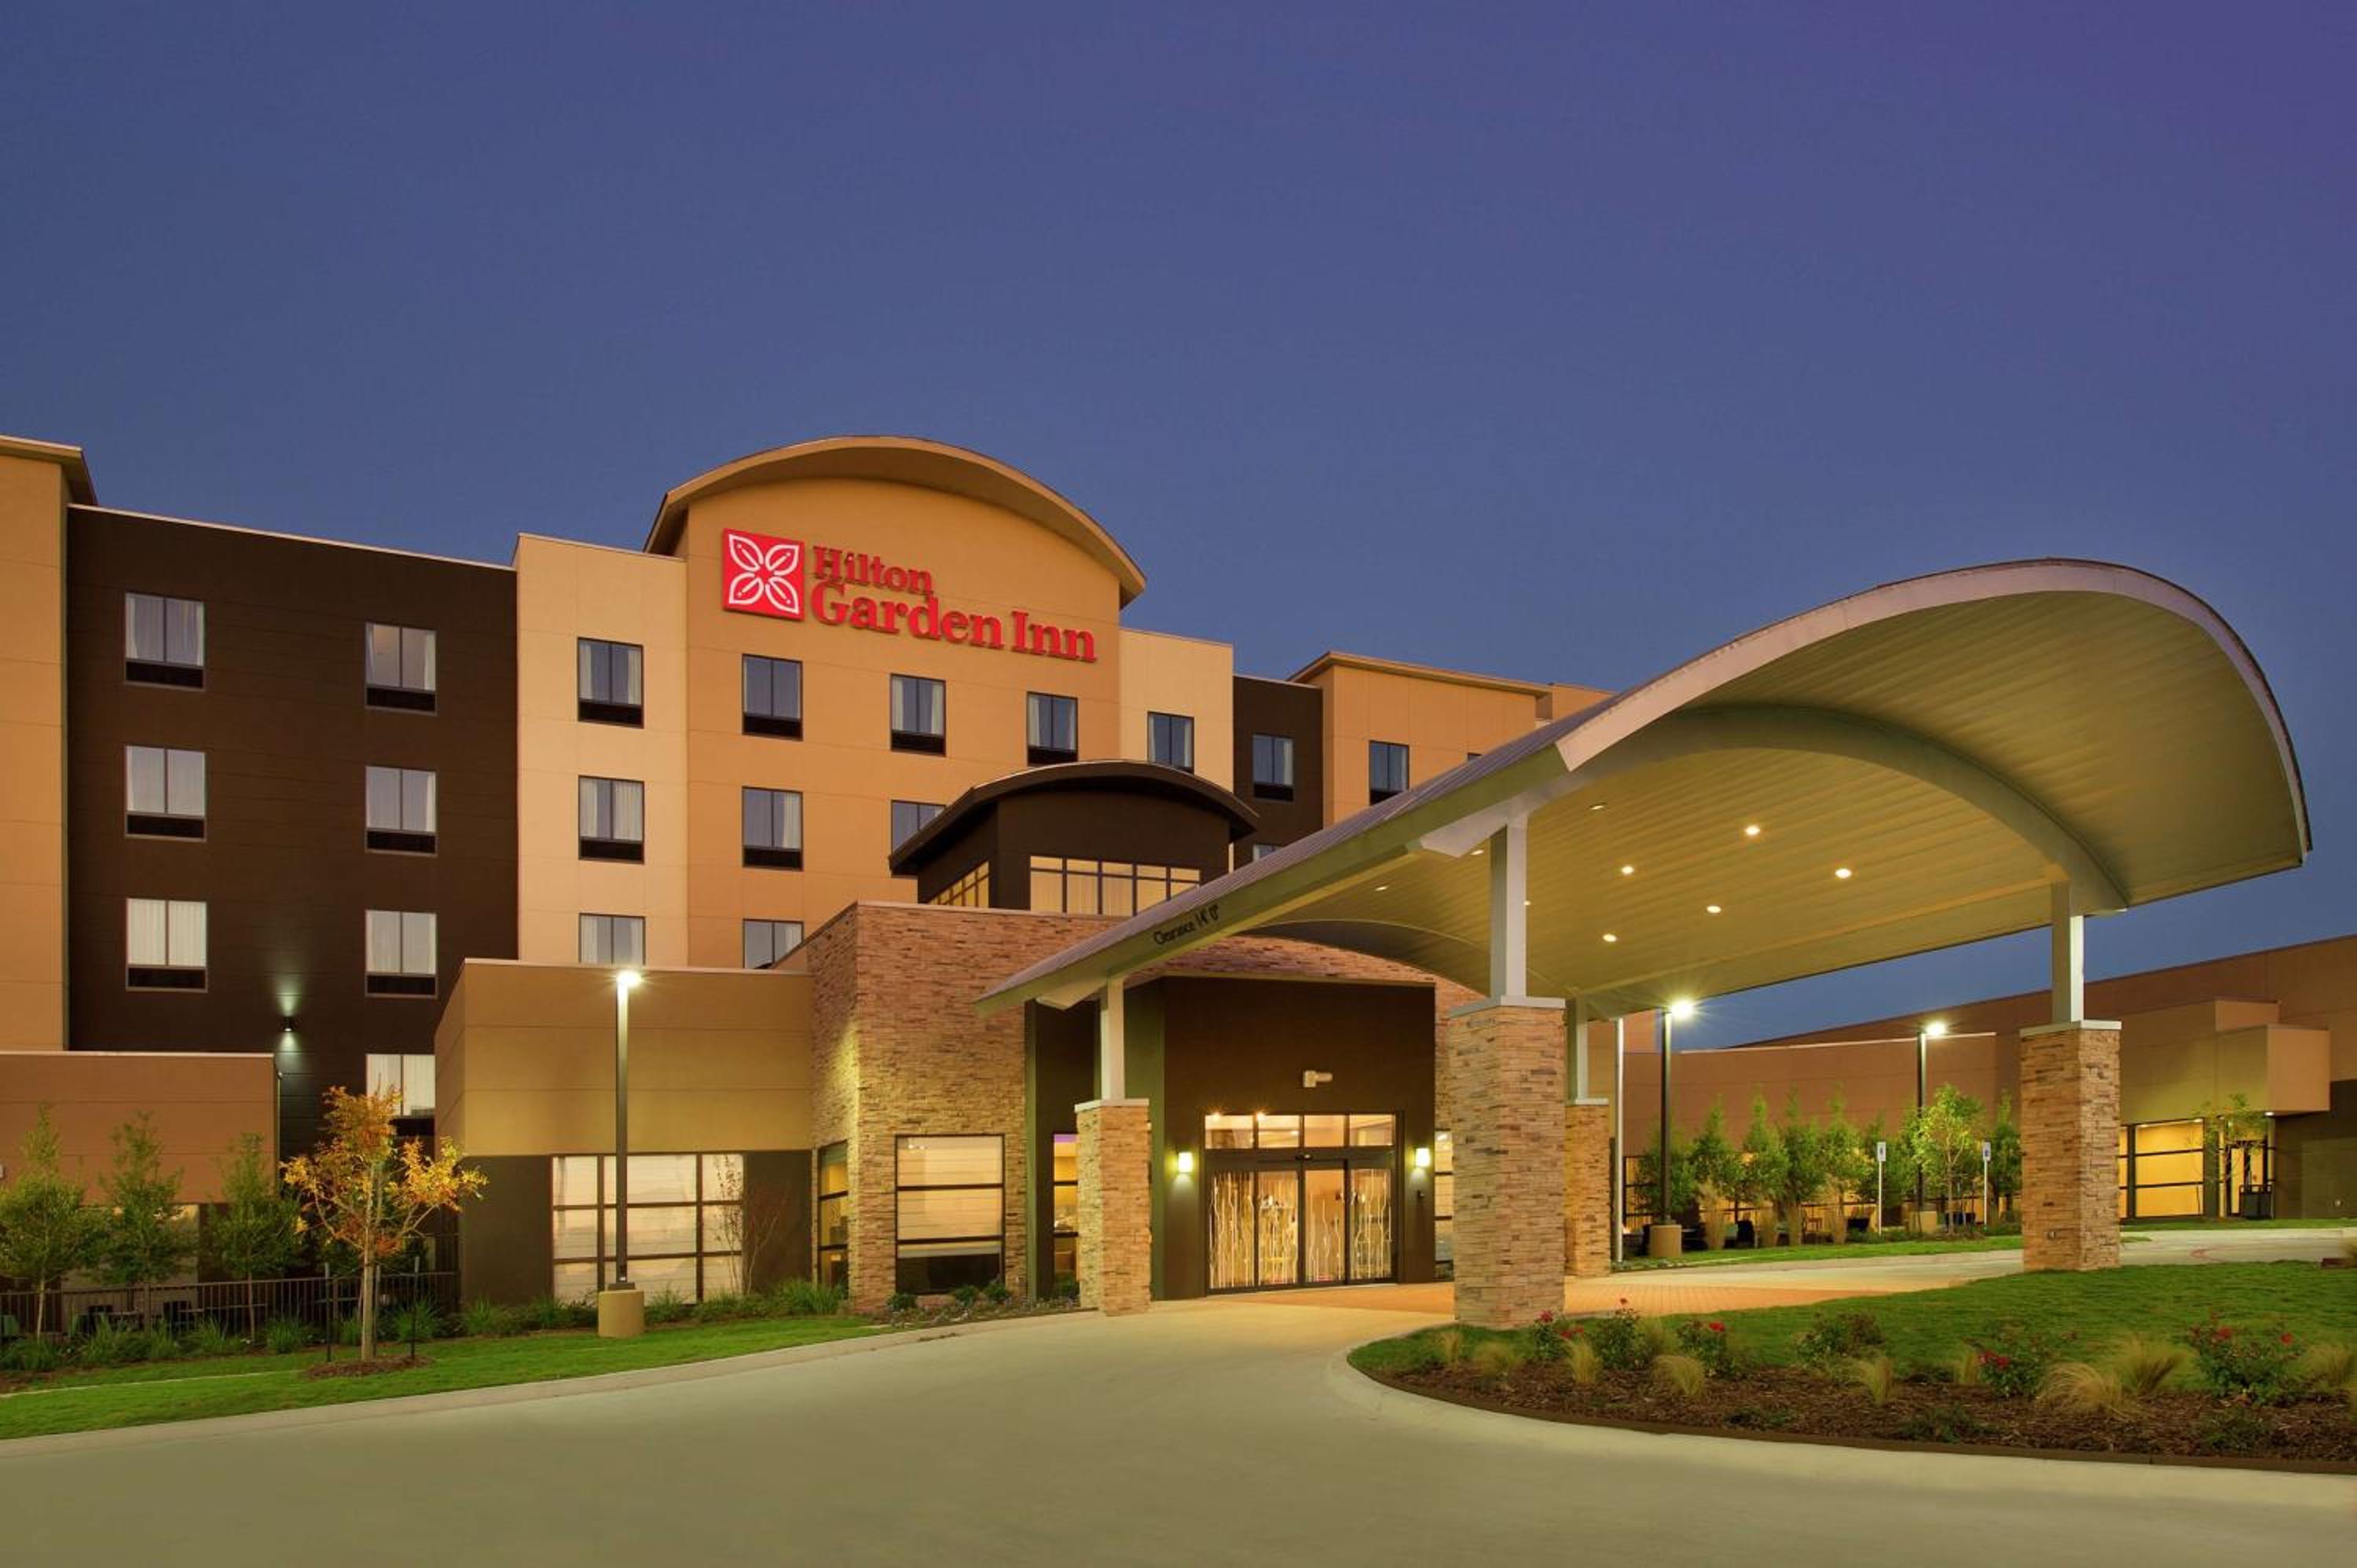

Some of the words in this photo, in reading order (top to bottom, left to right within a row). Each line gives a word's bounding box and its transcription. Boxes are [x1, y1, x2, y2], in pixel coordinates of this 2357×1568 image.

[813, 545, 934, 595] Hilton
[810, 580, 1005, 650] Garden
[1010, 610, 1098, 664] Inn
